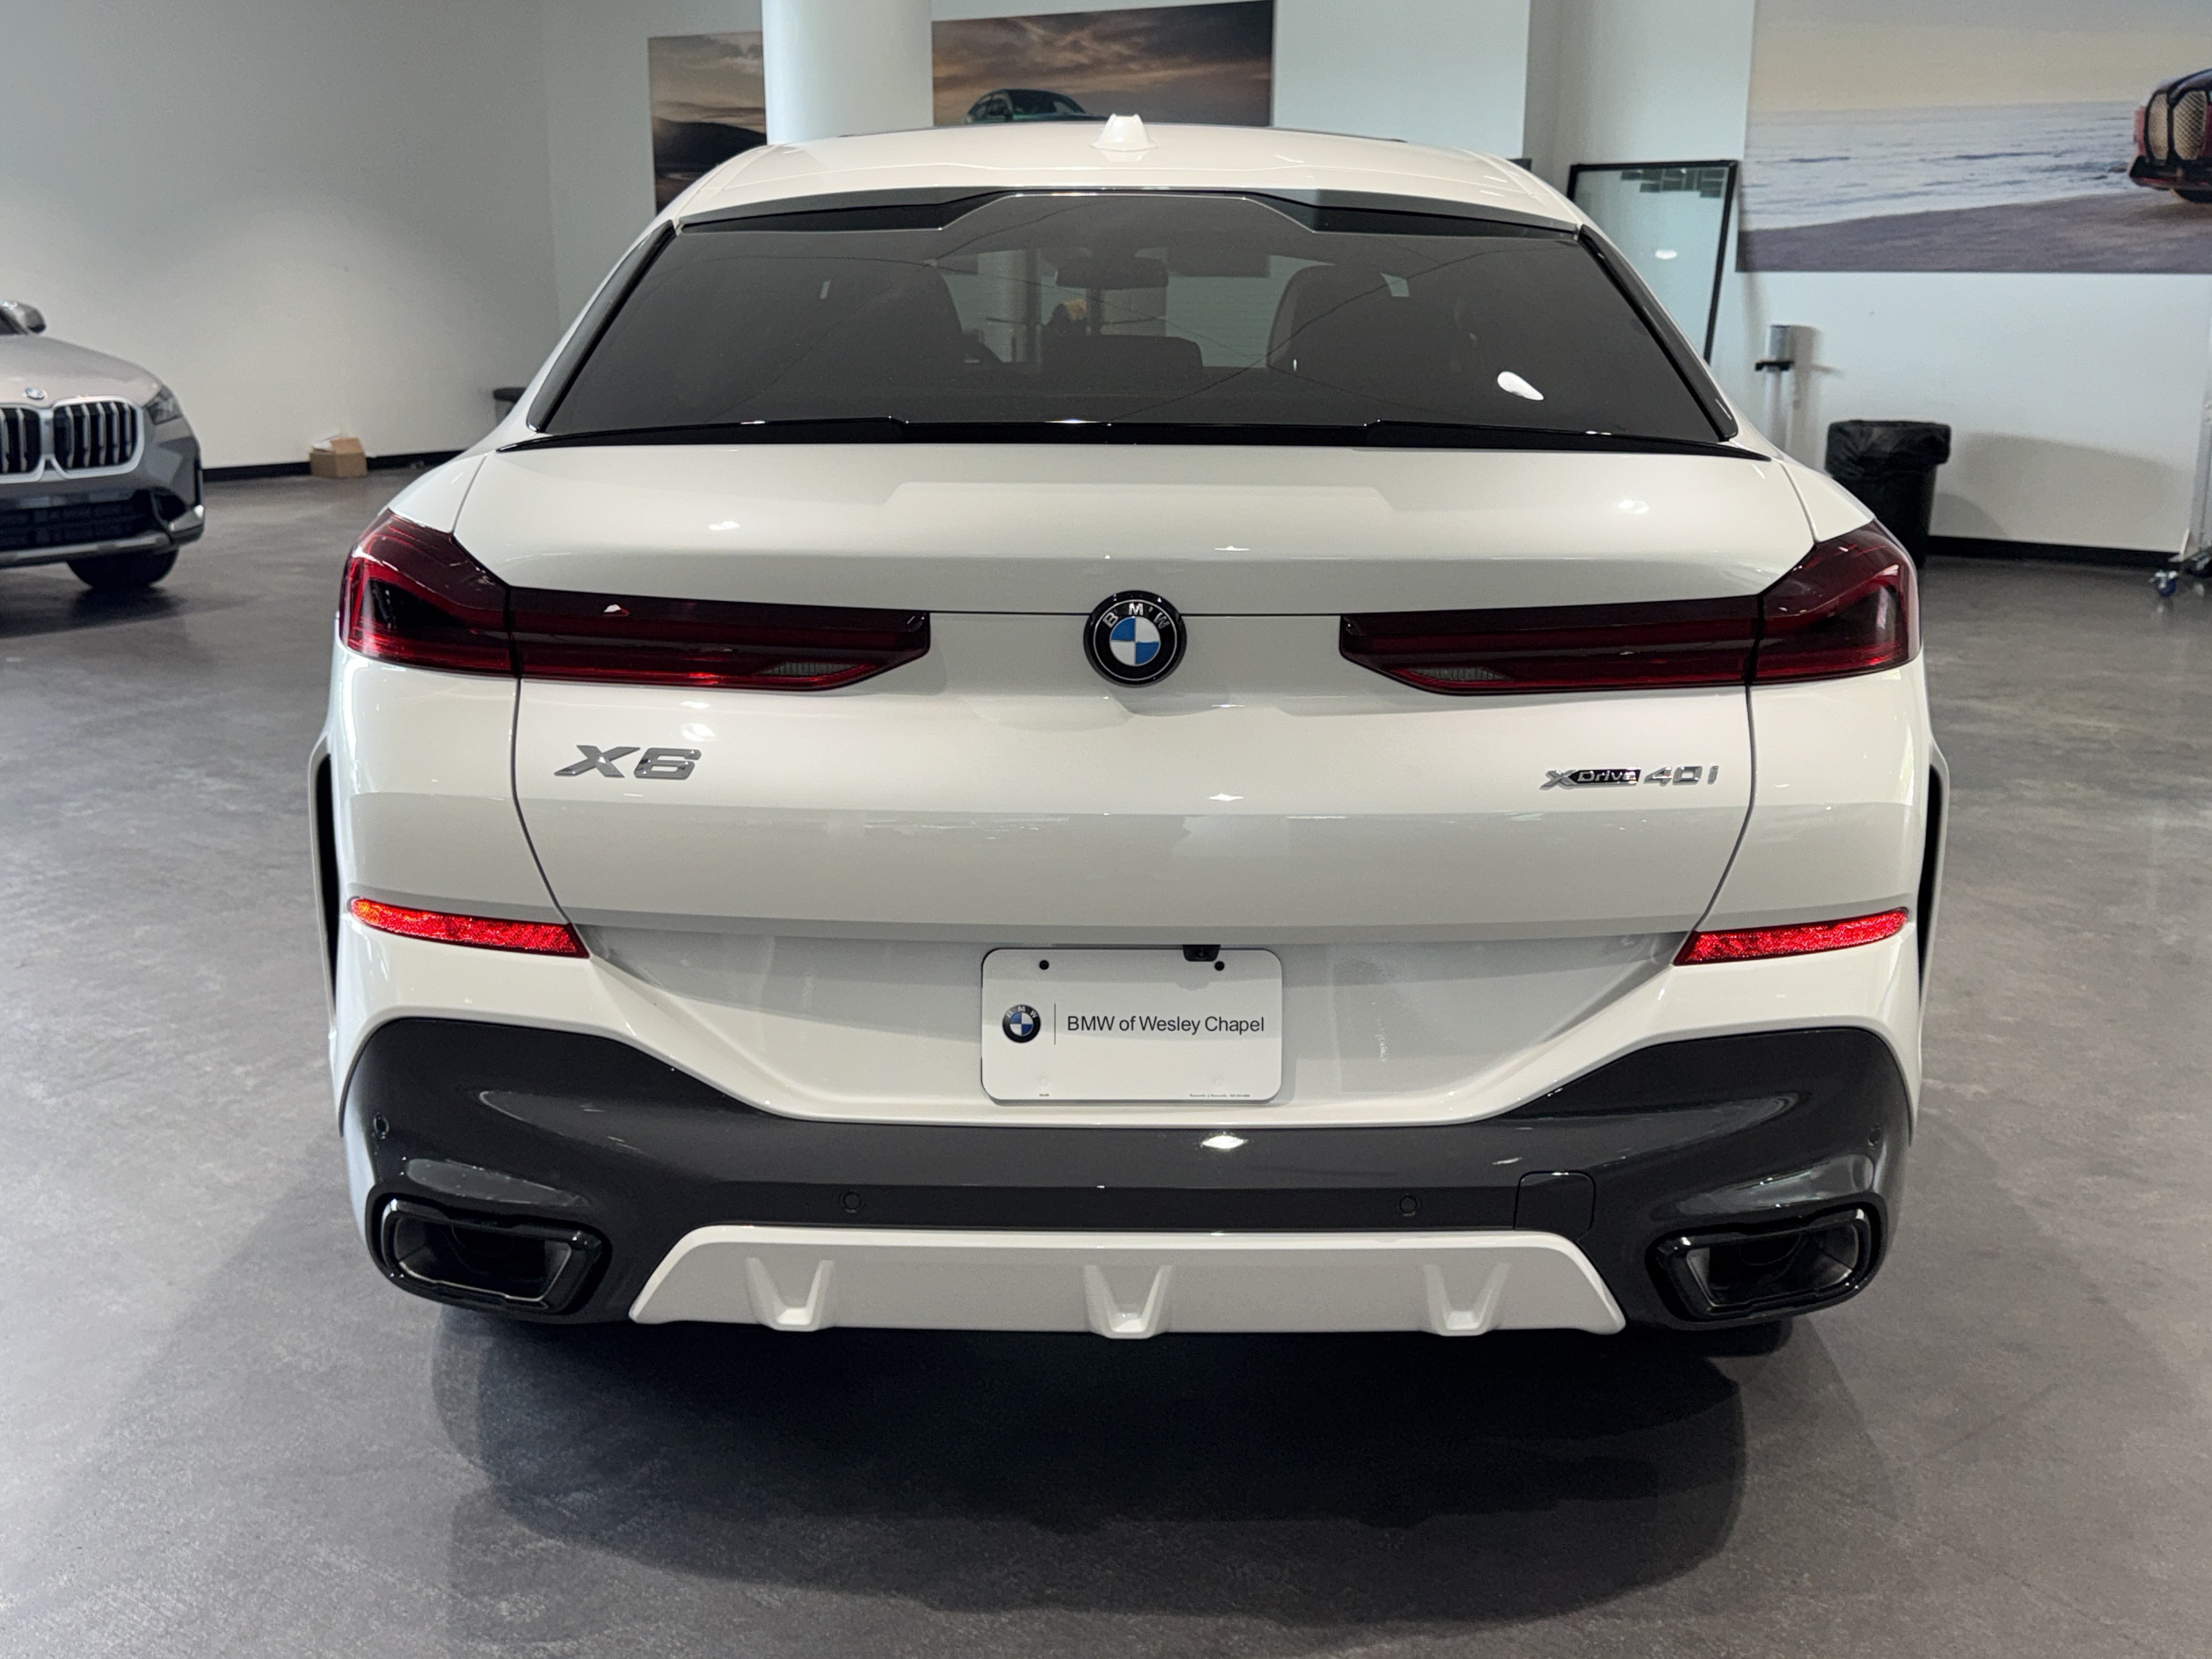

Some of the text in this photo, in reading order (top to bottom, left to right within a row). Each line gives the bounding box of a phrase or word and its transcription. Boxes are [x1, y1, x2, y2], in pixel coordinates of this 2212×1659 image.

[1102, 601, 1170, 629] BMW
[554, 745, 702, 780] X6
[1068, 1015, 1263, 1035] BMW of Wesley Chapel
